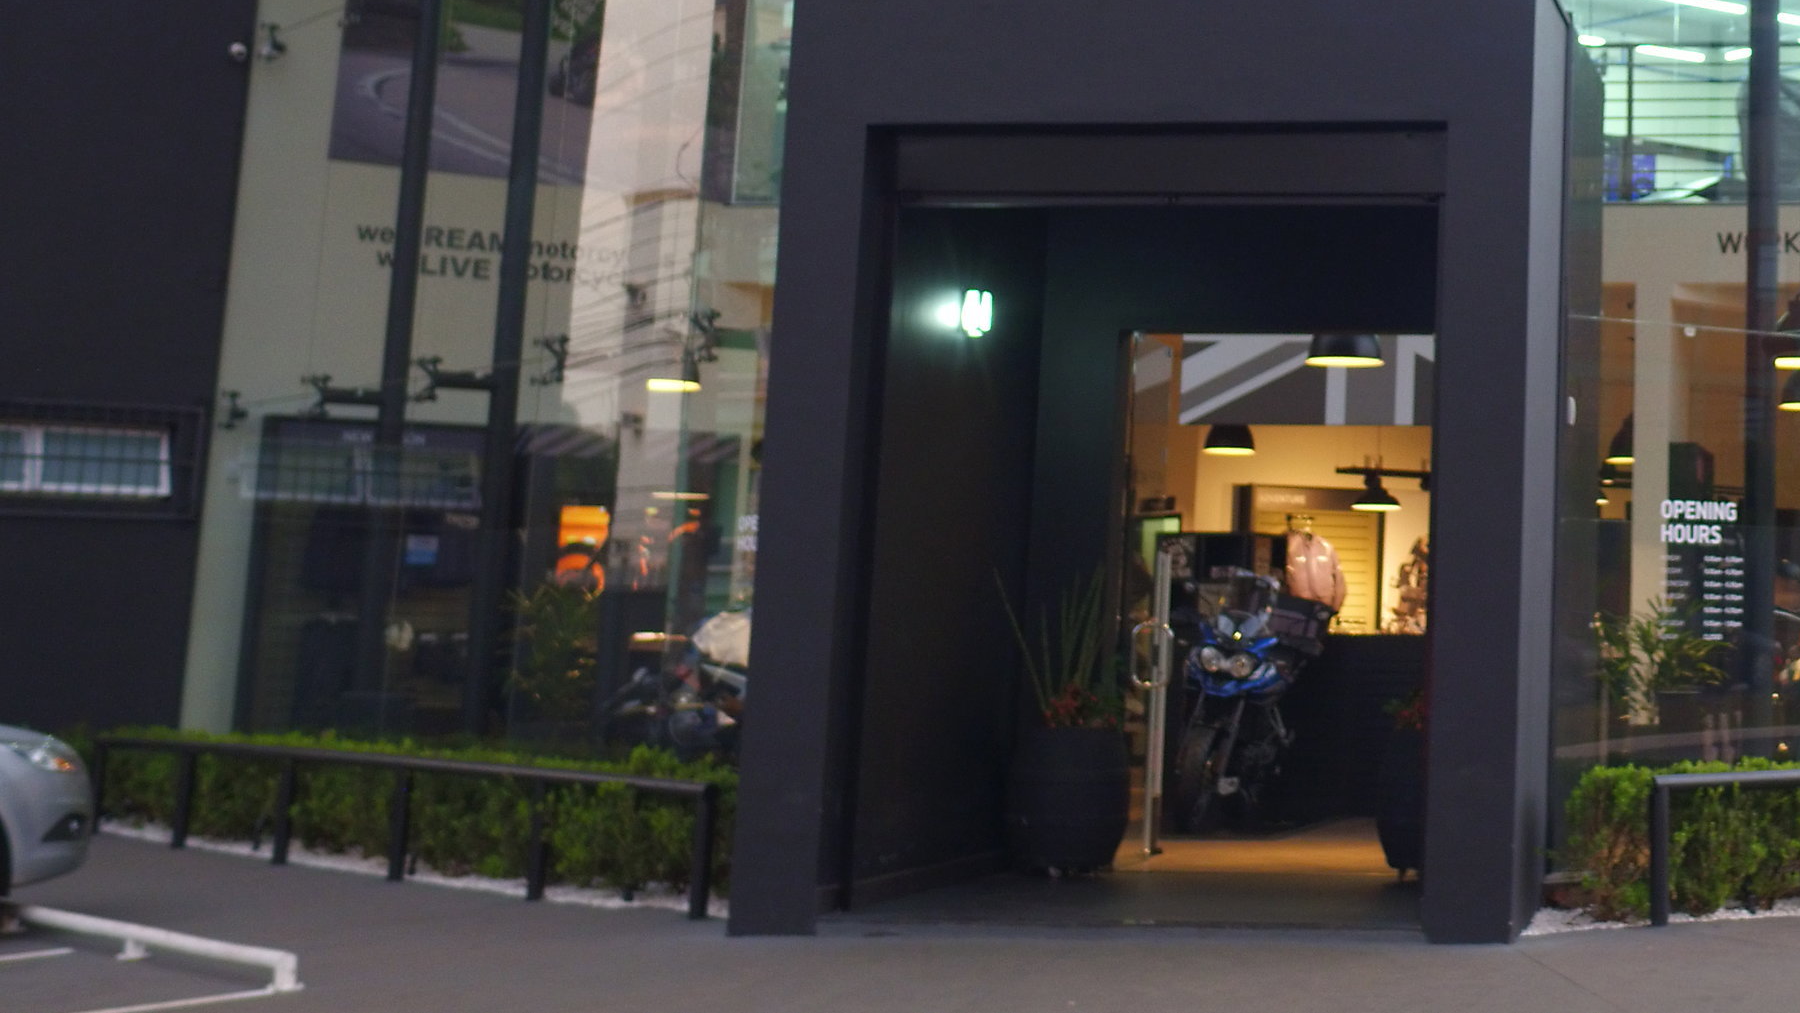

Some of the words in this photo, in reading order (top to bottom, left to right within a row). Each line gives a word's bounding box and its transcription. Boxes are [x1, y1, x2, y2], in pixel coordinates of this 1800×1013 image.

[420, 255, 492, 281] LIVE
[1660, 499, 1738, 521] OPENING
[1660, 524, 1722, 544] HOURS
